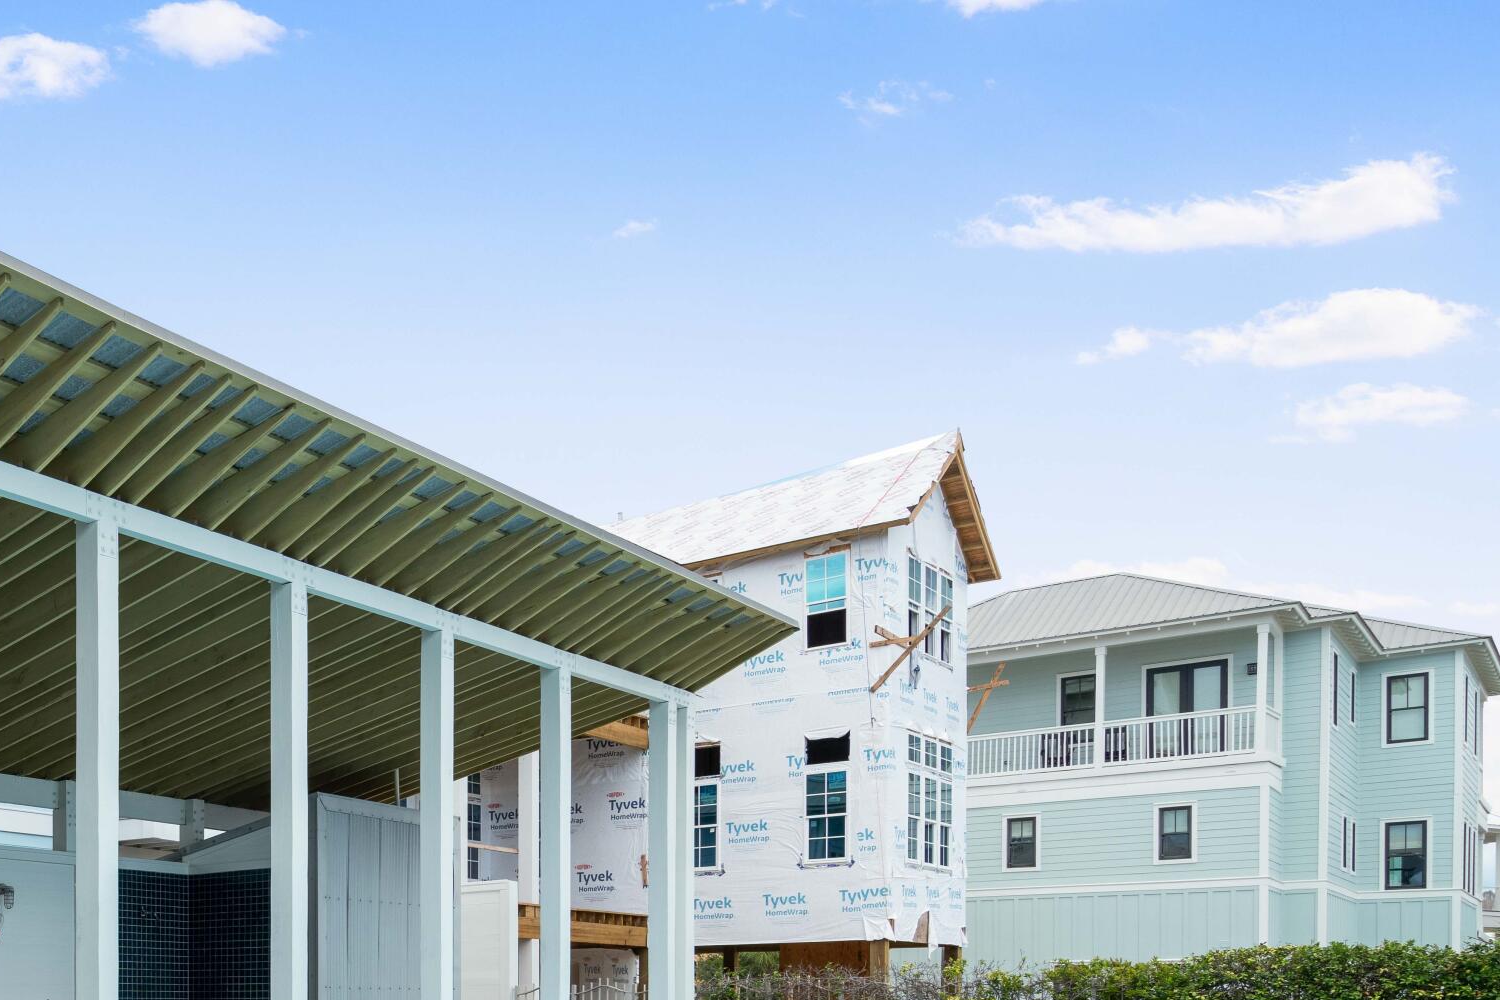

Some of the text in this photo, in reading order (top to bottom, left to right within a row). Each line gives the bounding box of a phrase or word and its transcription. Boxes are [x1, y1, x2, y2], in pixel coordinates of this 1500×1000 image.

[778, 573, 803, 587] Tyv
[781, 587, 803, 596] Home
[820, 654, 863, 666] HomeWrap
[744, 665, 786, 677] HomeWrap
[588, 750, 625, 760] HomeWrap
[721, 760, 755, 777] yvek
[721, 775, 756, 785] omeWrap
[609, 797, 645, 814] Tyvek
[610, 812, 647, 821] HomeWrap
[490, 823, 518, 831] HomeWra
[726, 819, 768, 836] Tyvek
[728, 835, 771, 844] HomeWrap
[577, 870, 612, 885] Tyvek
[578, 885, 614, 893] HomeWrap
[694, 897, 732, 912] Tyvek
[762, 892, 806, 908] Tyvek
[694, 912, 734, 920] HomeWrap
[765, 908, 808, 917] HomeWrap
[612, 964, 628, 977] Tyvek
